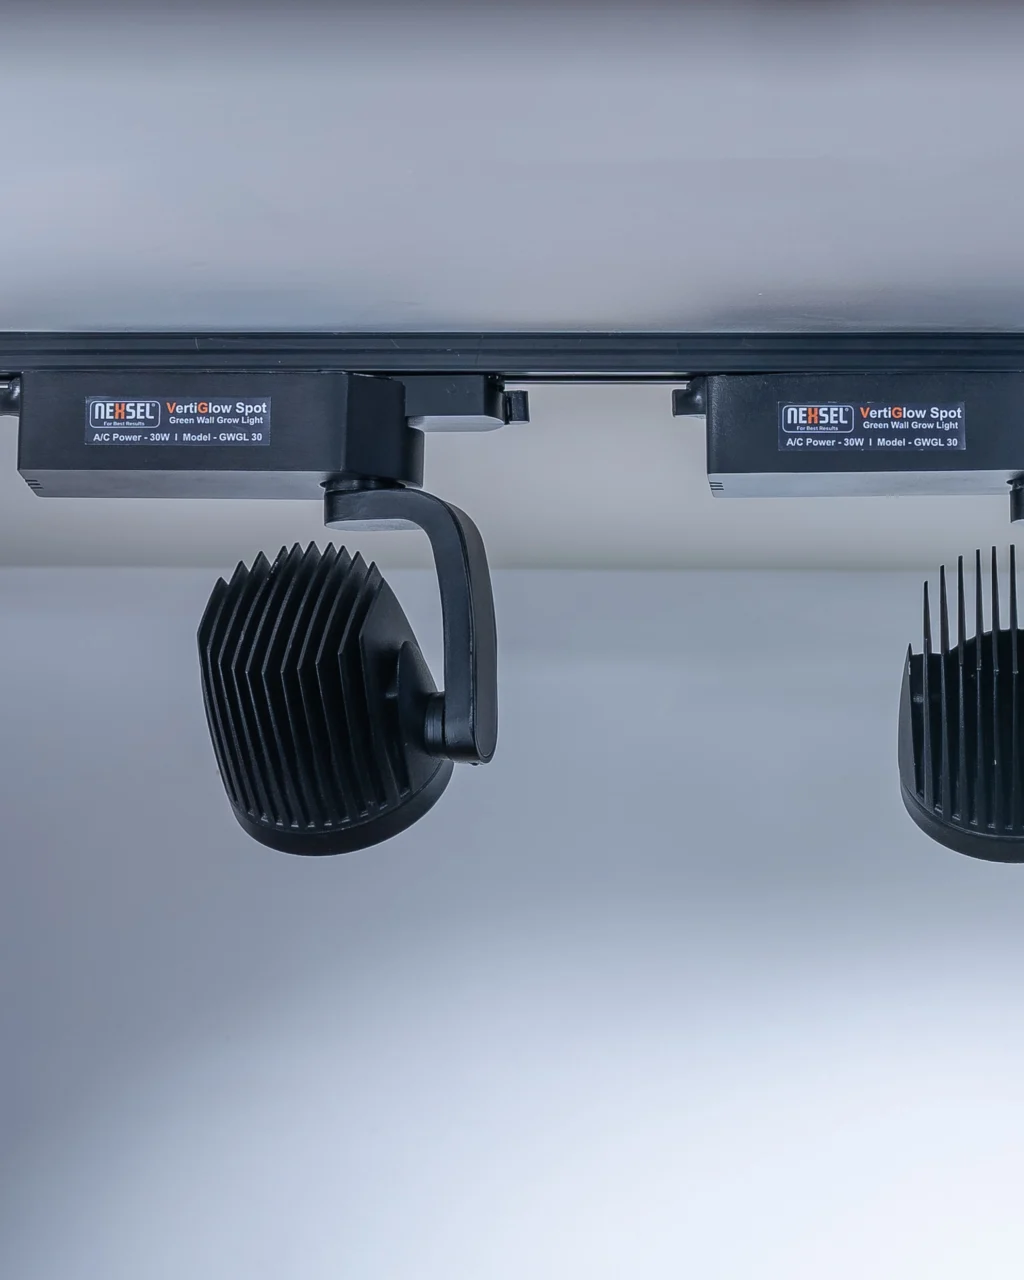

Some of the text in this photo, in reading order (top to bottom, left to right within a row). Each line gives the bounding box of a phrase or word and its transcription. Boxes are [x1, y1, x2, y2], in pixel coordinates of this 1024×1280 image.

[166, 402, 267, 416] VertiGlow Spot
[860, 407, 962, 421] VertiGlow Spot
[196, 416, 215, 424] Wall
[241, 416, 263, 425] Light
[863, 421, 958, 430] Green Wall Grow Light
[93, 433, 110, 441] A/C
[112, 433, 141, 441] Power
[150, 433, 170, 441] 30W
[183, 433, 211, 441] Model
[219, 433, 249, 441] GWGL
[251, 433, 262, 441] 30
[786, 438, 803, 447] A/C
[806, 438, 836, 447] Power
[844, 438, 864, 447] 30W
[877, 438, 905, 447] Model
[914, 438, 944, 447] GWGL
[947, 438, 958, 446] 30
